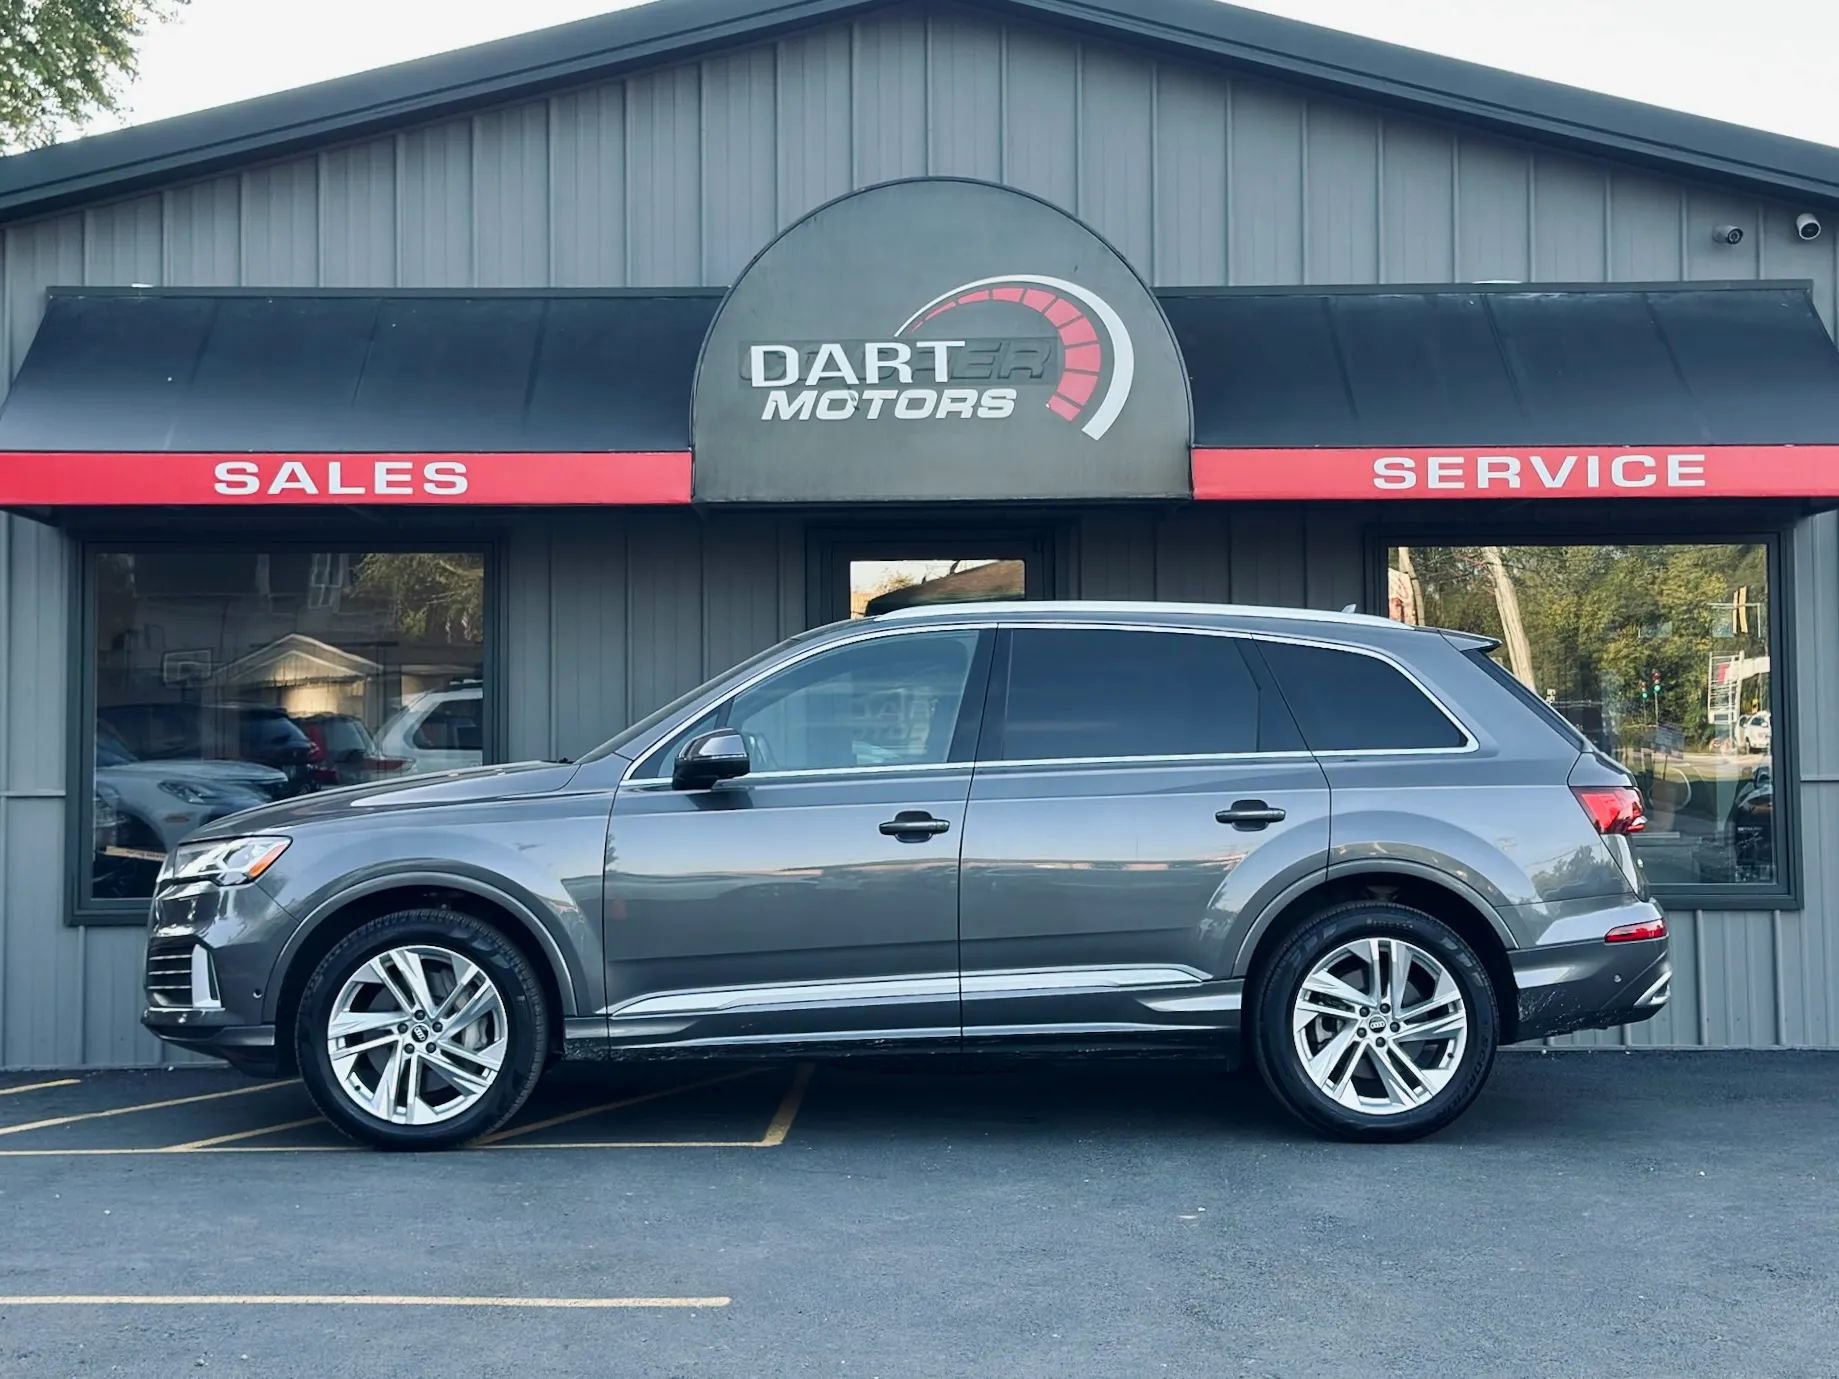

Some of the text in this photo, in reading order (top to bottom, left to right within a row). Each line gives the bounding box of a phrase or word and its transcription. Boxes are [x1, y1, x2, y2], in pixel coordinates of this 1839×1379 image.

[750, 340, 966, 387] DART
[761, 388, 1017, 421] MOTORS
[214, 461, 469, 495] SALES
[1373, 454, 1706, 489] SERVICE
